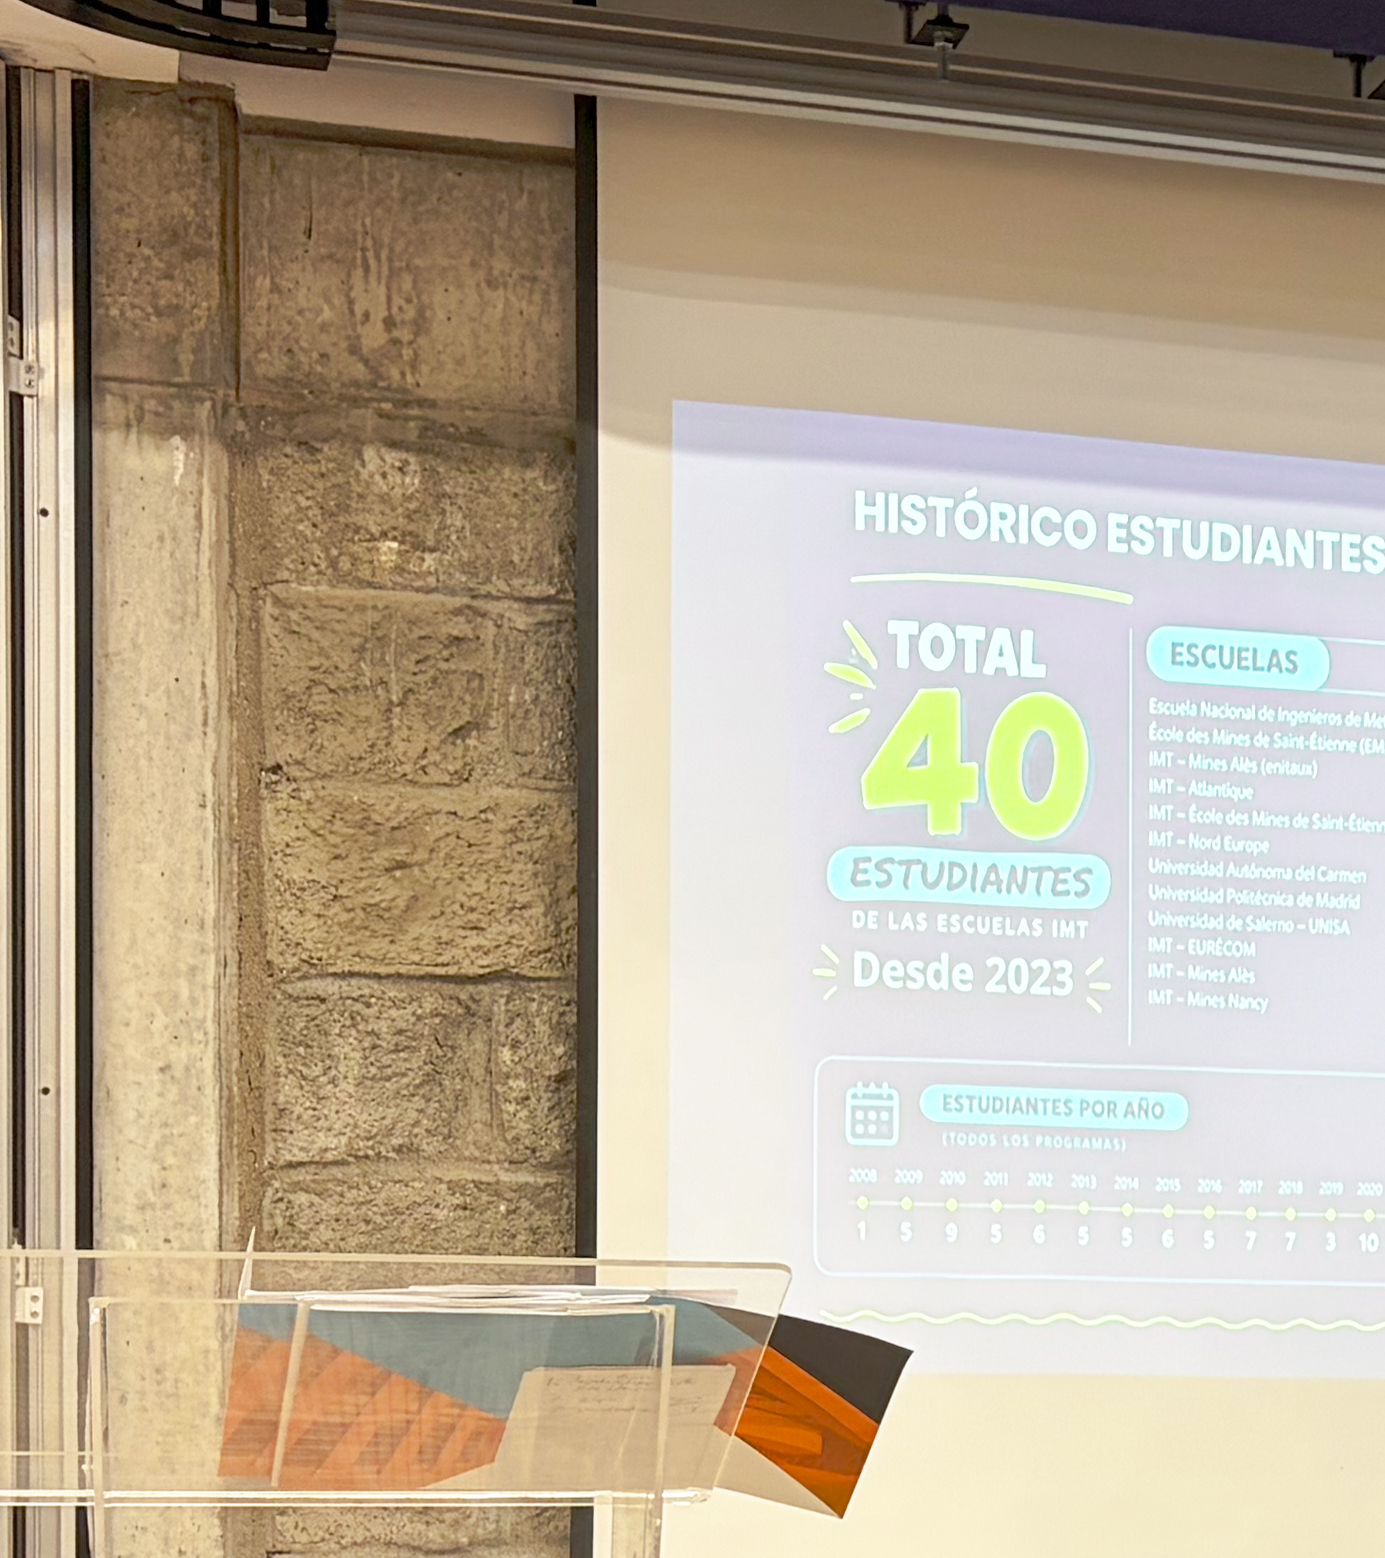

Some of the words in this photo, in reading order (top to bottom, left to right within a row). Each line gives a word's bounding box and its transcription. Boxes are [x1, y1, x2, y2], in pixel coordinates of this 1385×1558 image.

[855, 487, 1097, 550] HISTÓRICO
[1108, 513, 1385, 575] ESTUDIANTES
[888, 620, 1047, 678] TOTAL
[1171, 642, 1298, 674] ESCUELAS
[1149, 697, 1197, 716] Escuela
[1200, 700, 1256, 720] Nacional
[1258, 704, 1275, 722] de
[1278, 706, 1342, 728] Ingenieros
[1345, 710, 1362, 728] de
[1149, 721, 1183, 743] École
[1187, 727, 1209, 744] des
[1212, 728, 1250, 747] Mines
[1254, 732, 1270, 749] de
[1273, 732, 1357, 753] Saint-Étienne
[861, 687, 1089, 841] 40
[1149, 751, 1173, 768] IMT
[1189, 753, 1227, 771] Mines
[1149, 778, 1173, 795] IMT
[1188, 779, 1254, 802] Atlantique
[1149, 804, 1173, 821] IMT
[1189, 804, 1223, 825] École
[1226, 809, 1249, 826] des
[1252, 810, 1290, 829] Mines
[1292, 813, 1309, 829] de
[1149, 831, 1173, 848] IMT
[1189, 831, 1221, 851] Nord
[1224, 834, 1270, 856] Europe
[850, 856, 1094, 898] ESTUDIANTES
[1149, 857, 1223, 878] Universidad
[1226, 861, 1293, 881] Autónoma
[1295, 864, 1315, 881] del
[1317, 865, 1367, 884] Carmen
[1149, 883, 1223, 904] Universidad
[1226, 888, 1293, 907] Politécnica
[1297, 890, 1313, 907] de
[1316, 892, 1361, 910] Madrid
[852, 909, 879, 930] DE
[888, 911, 928, 932] LAS
[937, 914, 1043, 938] ESCUELAS
[1052, 919, 1089, 939] IMT
[1149, 910, 1223, 930] Universidad
[1226, 913, 1243, 930] de
[1246, 914, 1294, 933] Salerno
[1309, 917, 1350, 935] UNISA
[1149, 937, 1173, 954] IMT
[853, 950, 974, 992] Desde
[984, 957, 1074, 996] 2023
[1148, 963, 1173, 980] IMT
[1188, 964, 1225, 983] Mines
[1148, 989, 1173, 1006] IMT
[1187, 990, 1225, 1009] Mines
[1228, 992, 1269, 1014] Nancy
[943, 1093, 1074, 1117] ESTUDIANTES
[1080, 1099, 1118, 1119] POR
[1123, 1096, 1165, 1120] AÑO
[942, 1132, 997, 1148] (TODOS
[1003, 1133, 1030, 1148] LOS
[1035, 1135, 1127, 1152] PROGRAMAS)
[849, 1168, 878, 1184] 2008
[895, 1169, 923, 1185] 2009
[939, 1170, 966, 1186] 2010
[984, 1171, 1009, 1187] 2011
[1027, 1172, 1054, 1188] 2012
[1071, 1174, 1097, 1190] 2013
[1114, 1176, 1140, 1191] 2014
[1155, 1177, 1181, 1193] 2015
[1197, 1178, 1222, 1194] 2016
[1238, 1179, 1263, 1195] 2017
[1278, 1180, 1303, 1195] 2018
[1319, 1181, 1344, 1197] 2019
[1356, 1181, 1383, 1197] 2020
[858, 1221, 866, 1241] 1
[900, 1221, 912, 1242] 5
[945, 1222, 958, 1243] 9
[990, 1223, 1002, 1244] 5
[1033, 1224, 1046, 1244] 6
[1078, 1226, 1089, 1246] 5
[1121, 1227, 1132, 1247] 5
[1162, 1229, 1175, 1249] 6
[1203, 1230, 1215, 1250] 5
[1245, 1231, 1257, 1250] 7
[1285, 1231, 1296, 1251] 7
[1325, 1232, 1337, 1252] 3
[1359, 1233, 1379, 1253] 10
